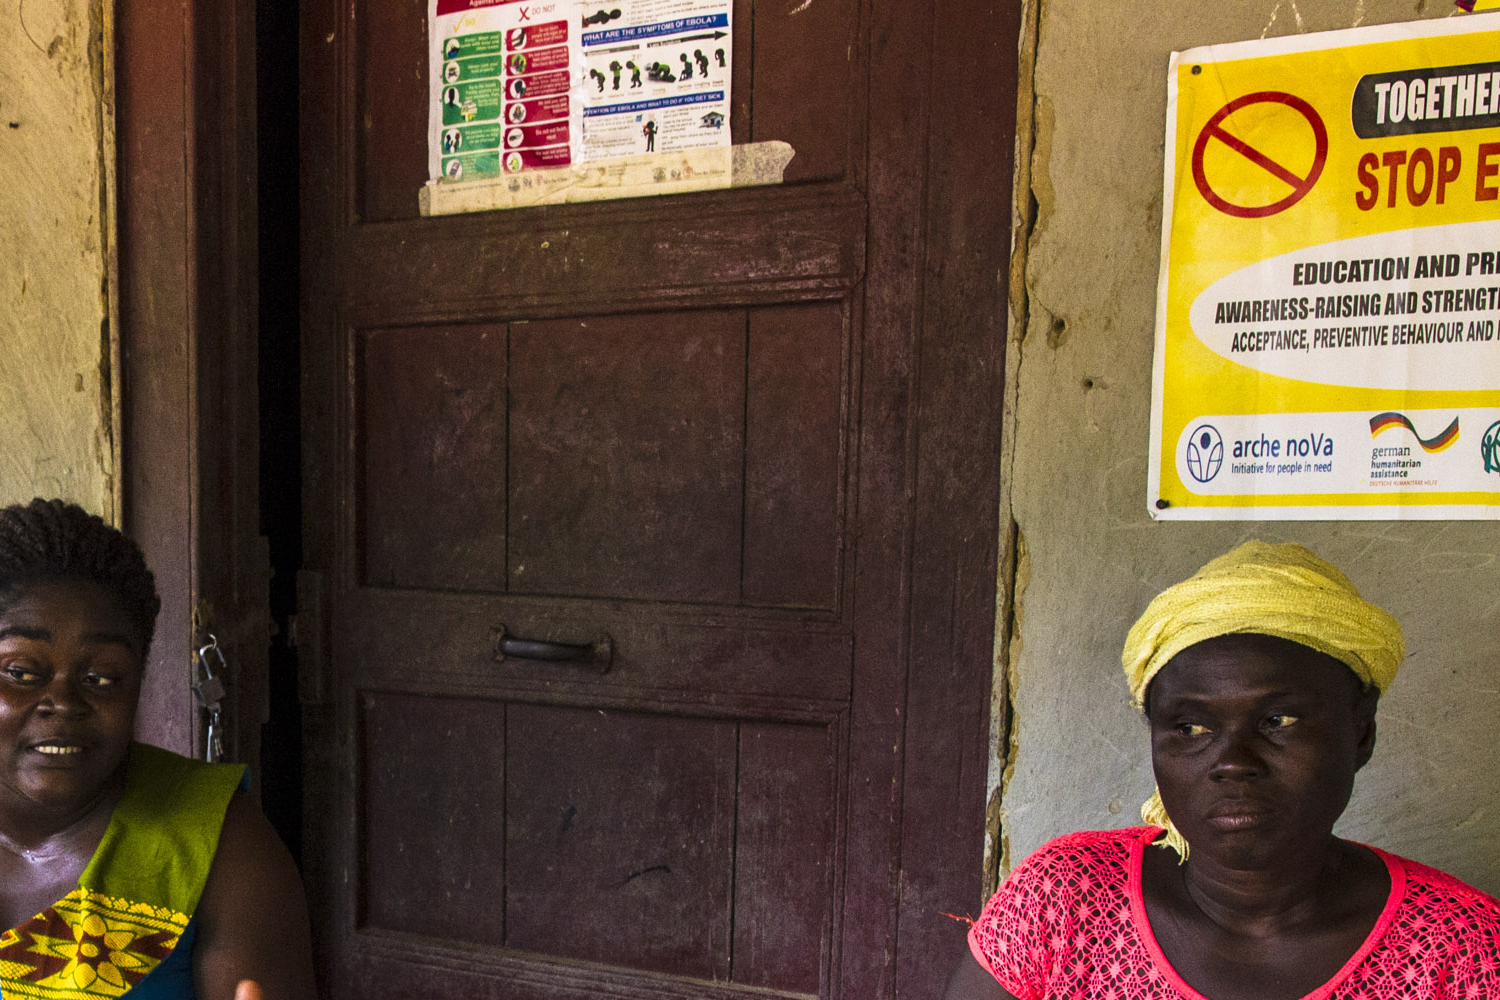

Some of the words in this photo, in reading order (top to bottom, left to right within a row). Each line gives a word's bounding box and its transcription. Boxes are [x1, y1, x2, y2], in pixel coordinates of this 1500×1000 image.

[583, 33, 603, 41] WHAT
[605, 30, 620, 38] ARE
[622, 28, 636, 36] THE
[637, 22, 674, 33] SYMPTOMS
[675, 20, 685, 28] OF
[686, 16, 717, 26] EBOLA?
[1355, 145, 1462, 211] STOP
[1293, 257, 1410, 286] EDUCATION
[1413, 254, 1461, 279] AND
[1215, 293, 1382, 324] AWARENESS-RAISING
[1384, 291, 1418, 316] AND
[1421, 286, 1500, 314] STRENGT
[1231, 328, 1310, 353] ACCEPTANCE,
[1313, 325, 1389, 349] PREVENTIVE
[1391, 321, 1465, 346] BEHAVIOUR
[1466, 320, 1494, 342] AND
[1232, 433, 1281, 458] arche
[1286, 433, 1333, 457] noVa
[1371, 446, 1411, 459] german
[1231, 463, 1264, 474] Initiative
[1265, 461, 1275, 473] for
[1277, 461, 1302, 475] people
[1304, 461, 1311, 472] in
[1313, 460, 1332, 472] need
[1370, 469, 1408, 479] assistance
[1371, 459, 1421, 469] humanitarian
